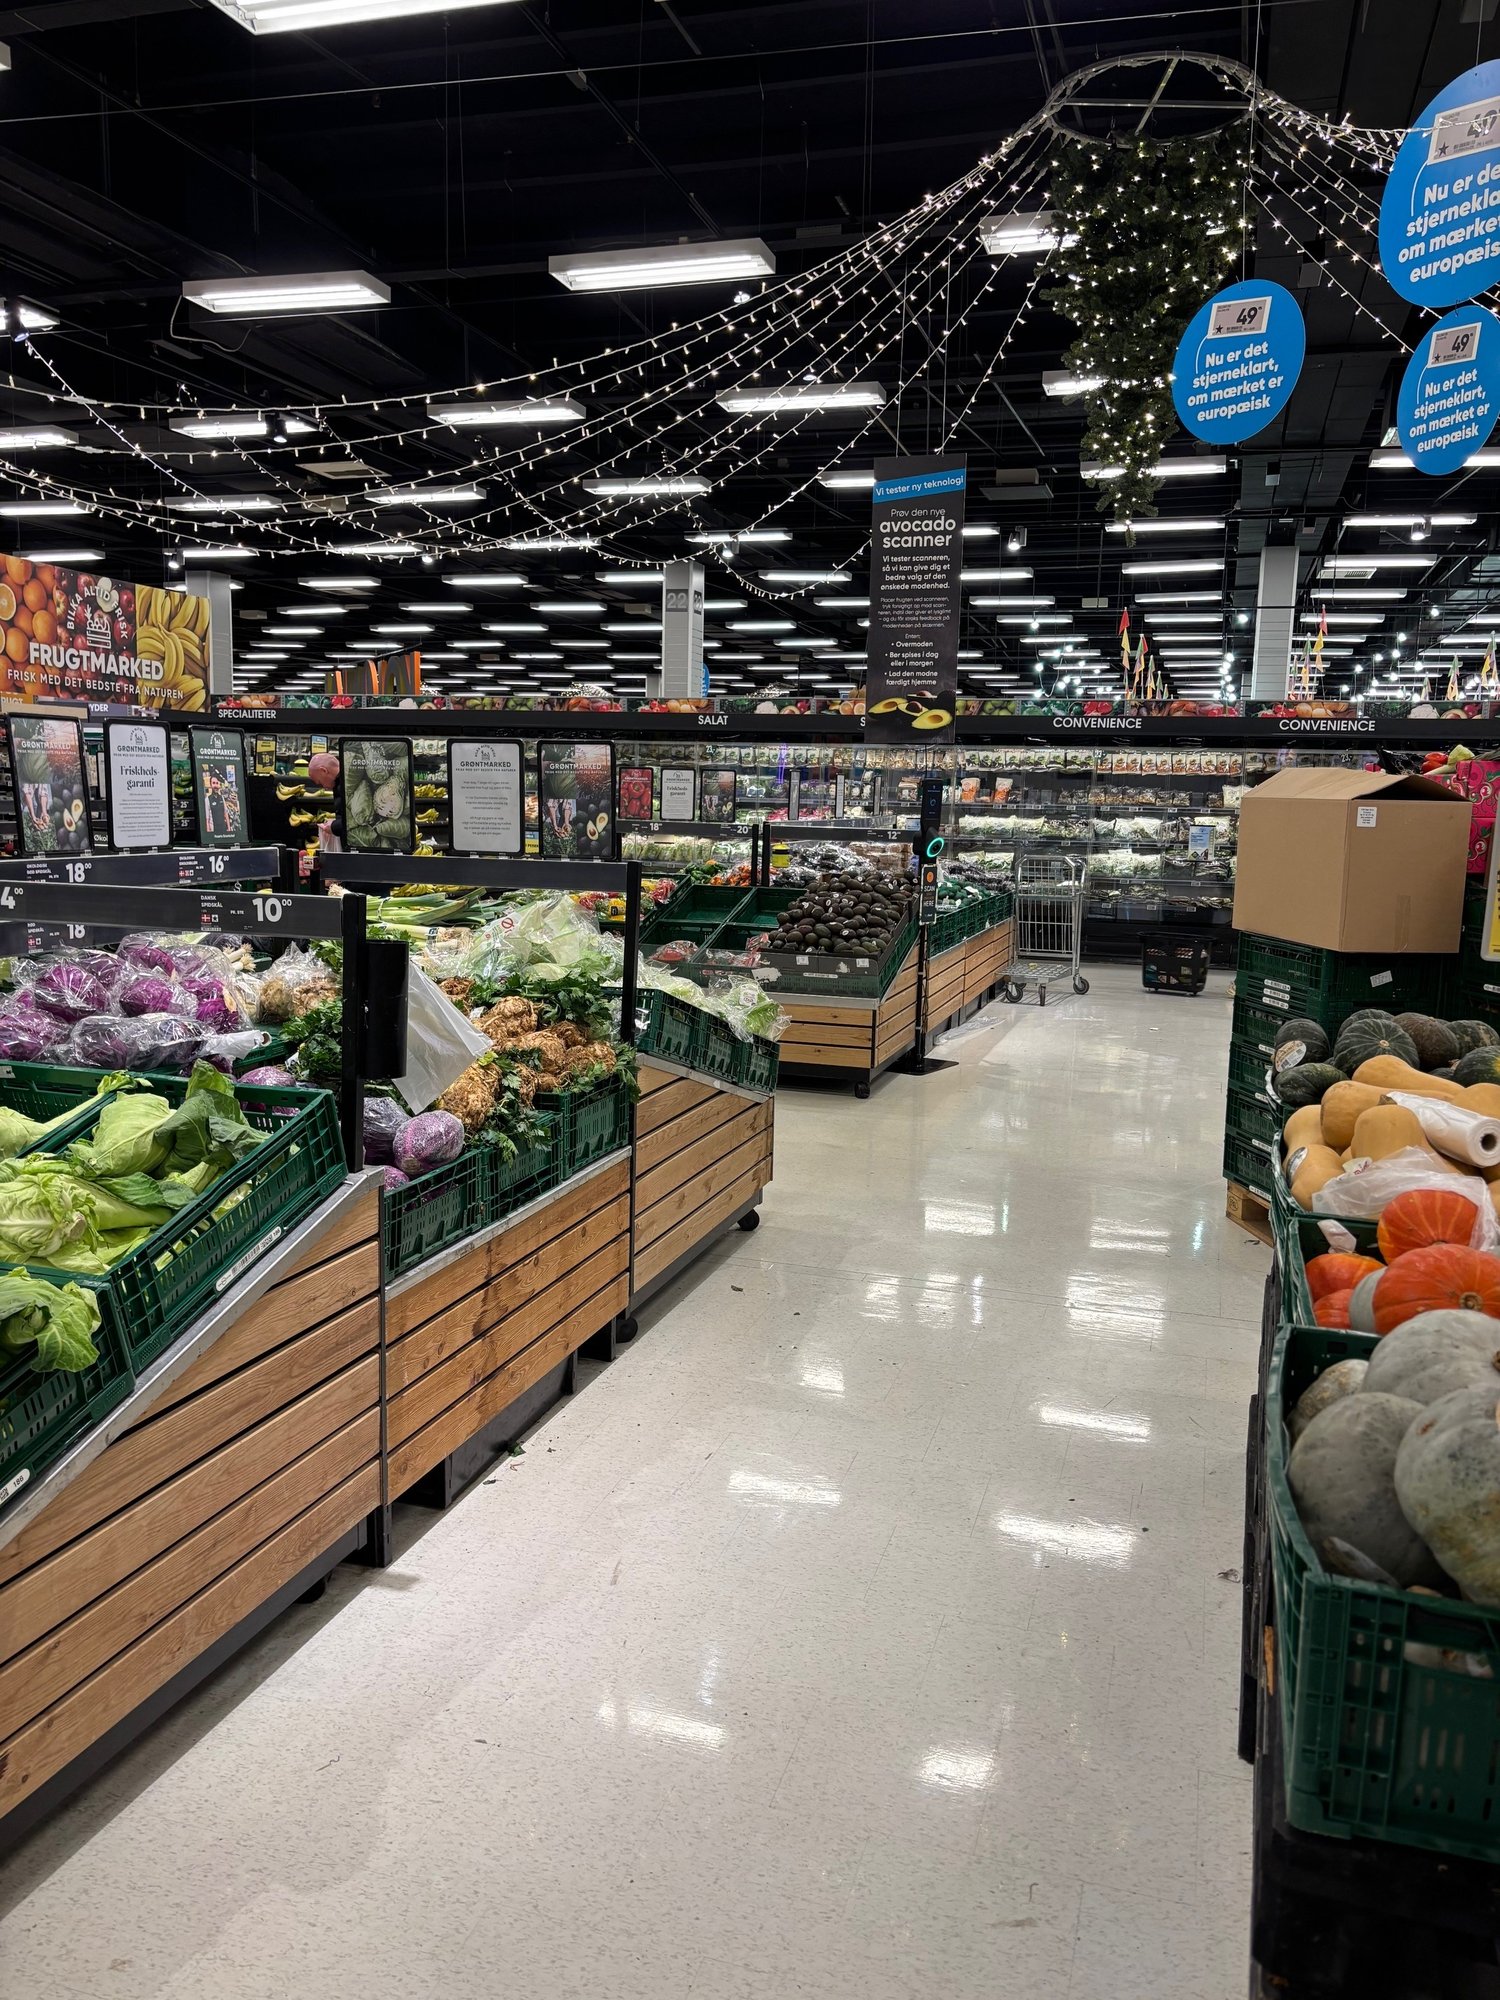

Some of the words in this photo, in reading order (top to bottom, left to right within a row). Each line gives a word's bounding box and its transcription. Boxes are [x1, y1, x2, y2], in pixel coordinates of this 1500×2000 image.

[1424, 183, 1448, 206] Nu
[1452, 174, 1474, 192] er
[1398, 242, 1426, 263] om
[1429, 215, 1500, 252] mærke
[1236, 306, 1258, 326] 49
[1452, 333, 1470, 353] 49
[1206, 354, 1224, 368] Nu
[1227, 350, 1241, 361] er
[1244, 341, 1268, 357] det
[1192, 358, 1279, 390] stjerneklart,
[1425, 382, 1440, 398] Nu
[1442, 378, 1455, 391] er
[1457, 368, 1478, 386] det
[1187, 392, 1208, 407] om
[1210, 378, 1266, 402] mærket
[1268, 375, 1284, 389] er
[1197, 394, 1271, 422] europæisk
[1414, 384, 1486, 420] stjerneklart,
[1409, 423, 1426, 438] om
[1428, 405, 1475, 428] mærket
[1477, 402, 1490, 416] er
[1417, 422, 1480, 452] europæisk
[886, 485, 910, 495] tester
[912, 483, 922, 491] ny
[924, 476, 964, 489] teknologi
[891, 509, 909, 517] Prøv
[911, 508, 928, 516] den
[930, 508, 945, 517] nye
[880, 516, 956, 533] avocado
[883, 535, 952, 548] scanner
[930, 564, 941, 572] dig
[667, 592, 687, 608] 22
[67, 593, 83, 630] BILKA
[84, 586, 110, 600] ALTID
[112, 601, 128, 639] FRISK
[29, 642, 164, 681] FRUGTMARKED
[8, 669, 36, 682] FRISK
[40, 673, 61, 685] MED
[65, 678, 82, 688] DET
[86, 679, 121, 692] BEDSTE
[123, 684, 141, 695] FRA
[144, 686, 184, 699] NATUREN
[218, 709, 276, 719] SPECIALITETER
[698, 715, 728, 725] SALAT
[1053, 717, 1142, 729] CONVENIENCE
[1279, 720, 1376, 732] CONVENIENCE
[120, 766, 159, 776] Friskheds-
[127, 779, 155, 790] garanti
[649, 823, 659, 831] 18
[736, 825, 749, 834] 20
[887, 831, 897, 839] 12
[66, 863, 85, 883] 18
[209, 855, 224, 873] 16
[252, 898, 282, 922] 10
